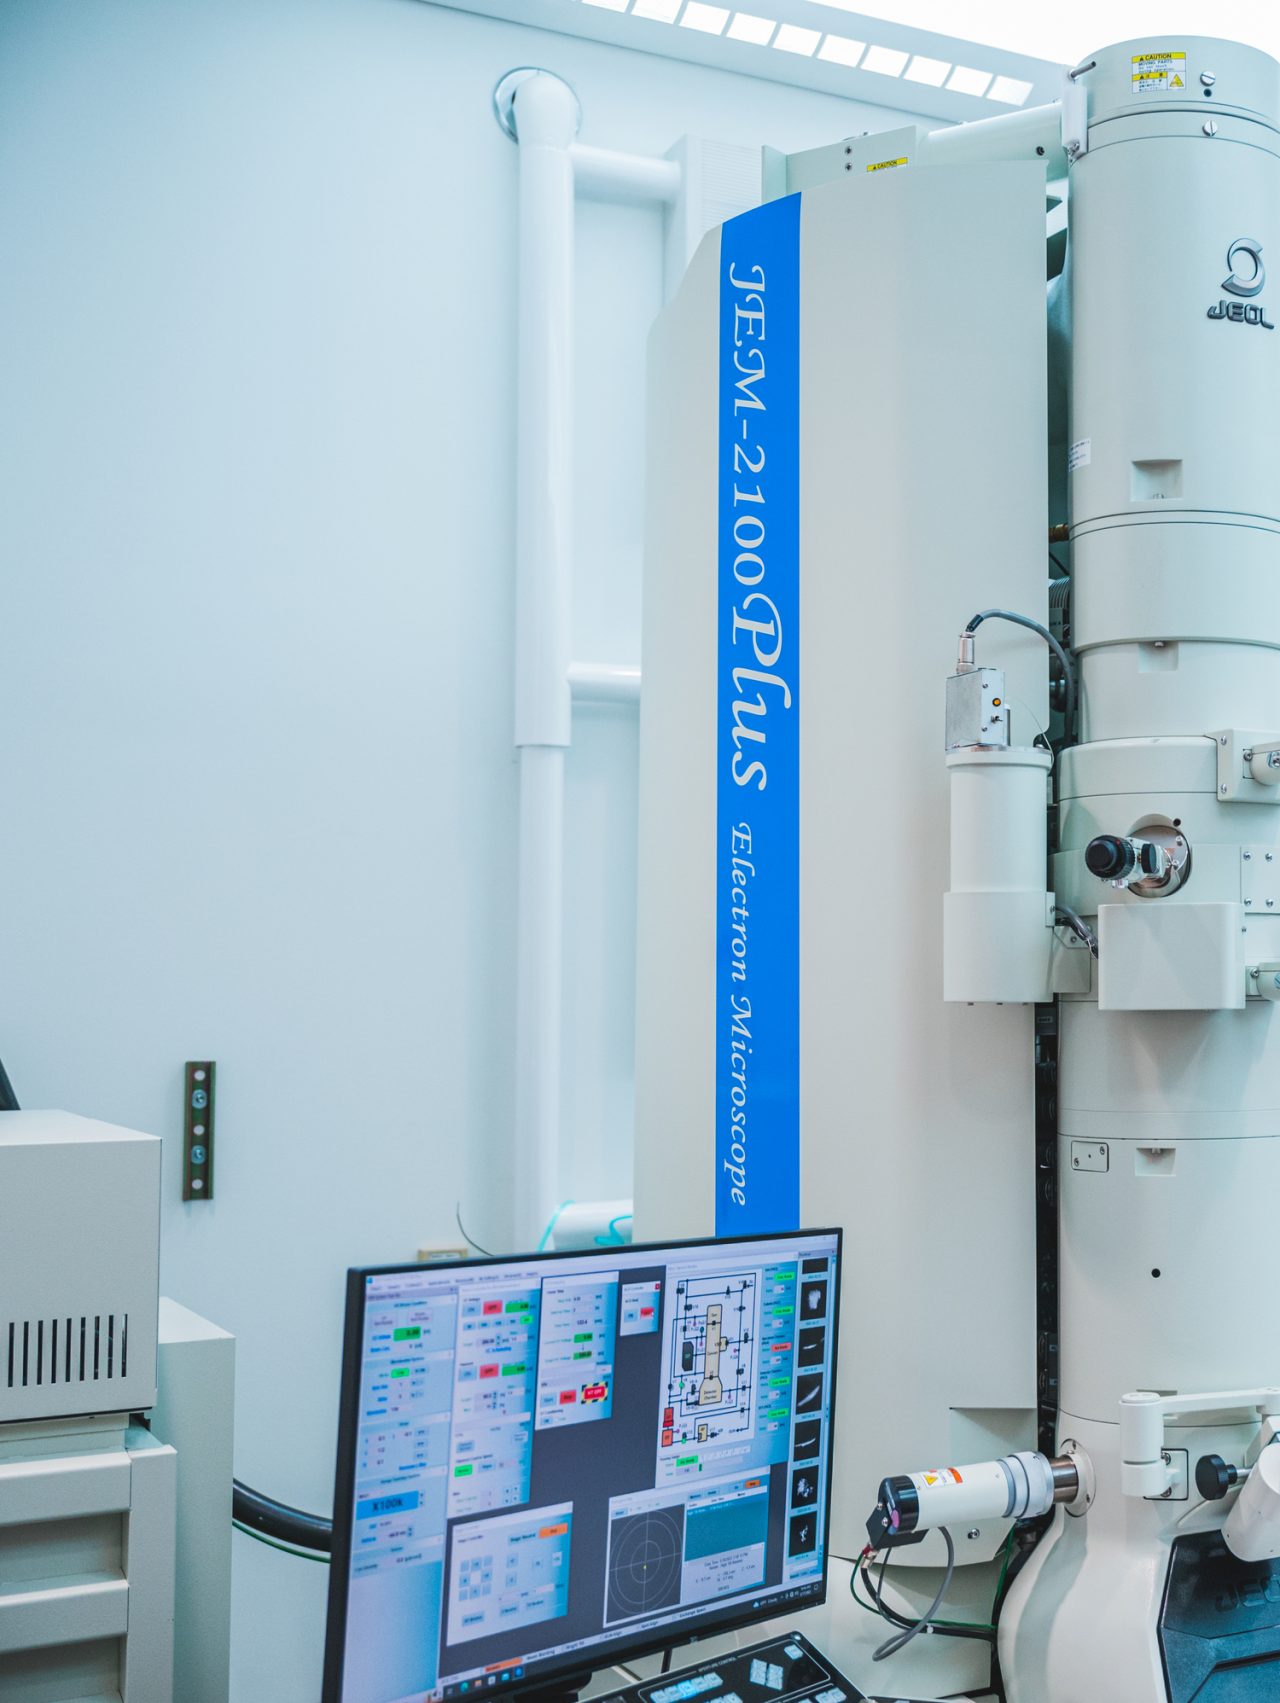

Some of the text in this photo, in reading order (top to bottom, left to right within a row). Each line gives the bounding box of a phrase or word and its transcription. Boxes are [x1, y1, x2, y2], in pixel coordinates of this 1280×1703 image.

[1145, 53, 1171, 61] CAUTION
[877, 160, 897, 169] CAUTION
[1207, 300, 1275, 330] JEOL
[732, 821, 756, 983] Electron
[723, 994, 753, 1207] Microscope
